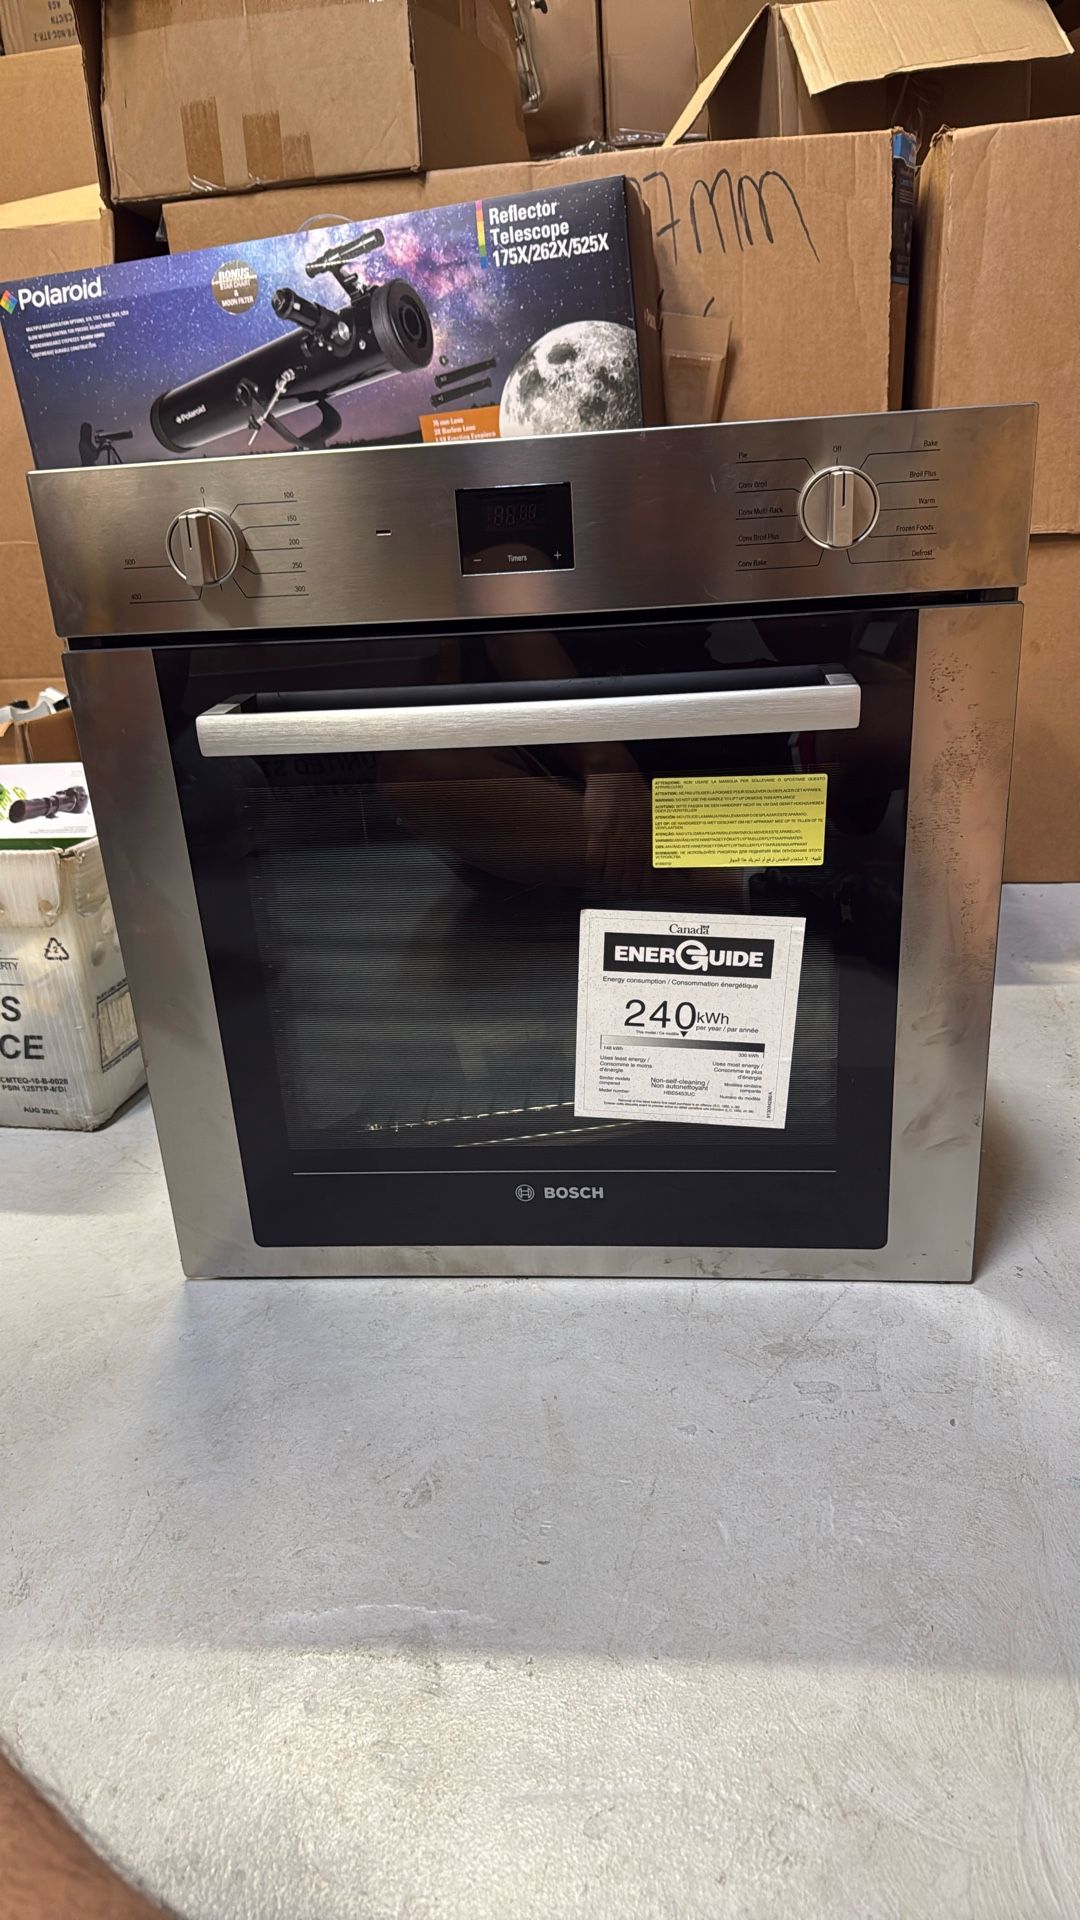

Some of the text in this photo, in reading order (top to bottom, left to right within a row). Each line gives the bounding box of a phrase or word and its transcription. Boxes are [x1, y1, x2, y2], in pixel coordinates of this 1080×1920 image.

[488, 202, 558, 226] Reflector
[490, 221, 570, 246] Telescope
[493, 232, 610, 268] 175X/262X/525X
[18, 275, 102, 310] Polaroid
[832, 444, 842, 453] Off
[284, 491, 294, 499] 100
[508, 554, 528, 562] Timers
[669, 924, 710, 935] Canada
[614, 940, 764, 972] ENERGUIDE
[672, 979, 720, 987] Consommation
[720, 981, 758, 990] énergétique
[1, 996, 22, 1022] S
[624, 999, 729, 1030] 240 kWh
[0, 1034, 45, 1060] CE
[650, 1077, 706, 1086] Non-self-cleaning
[544, 1186, 604, 1199] BOSCH
